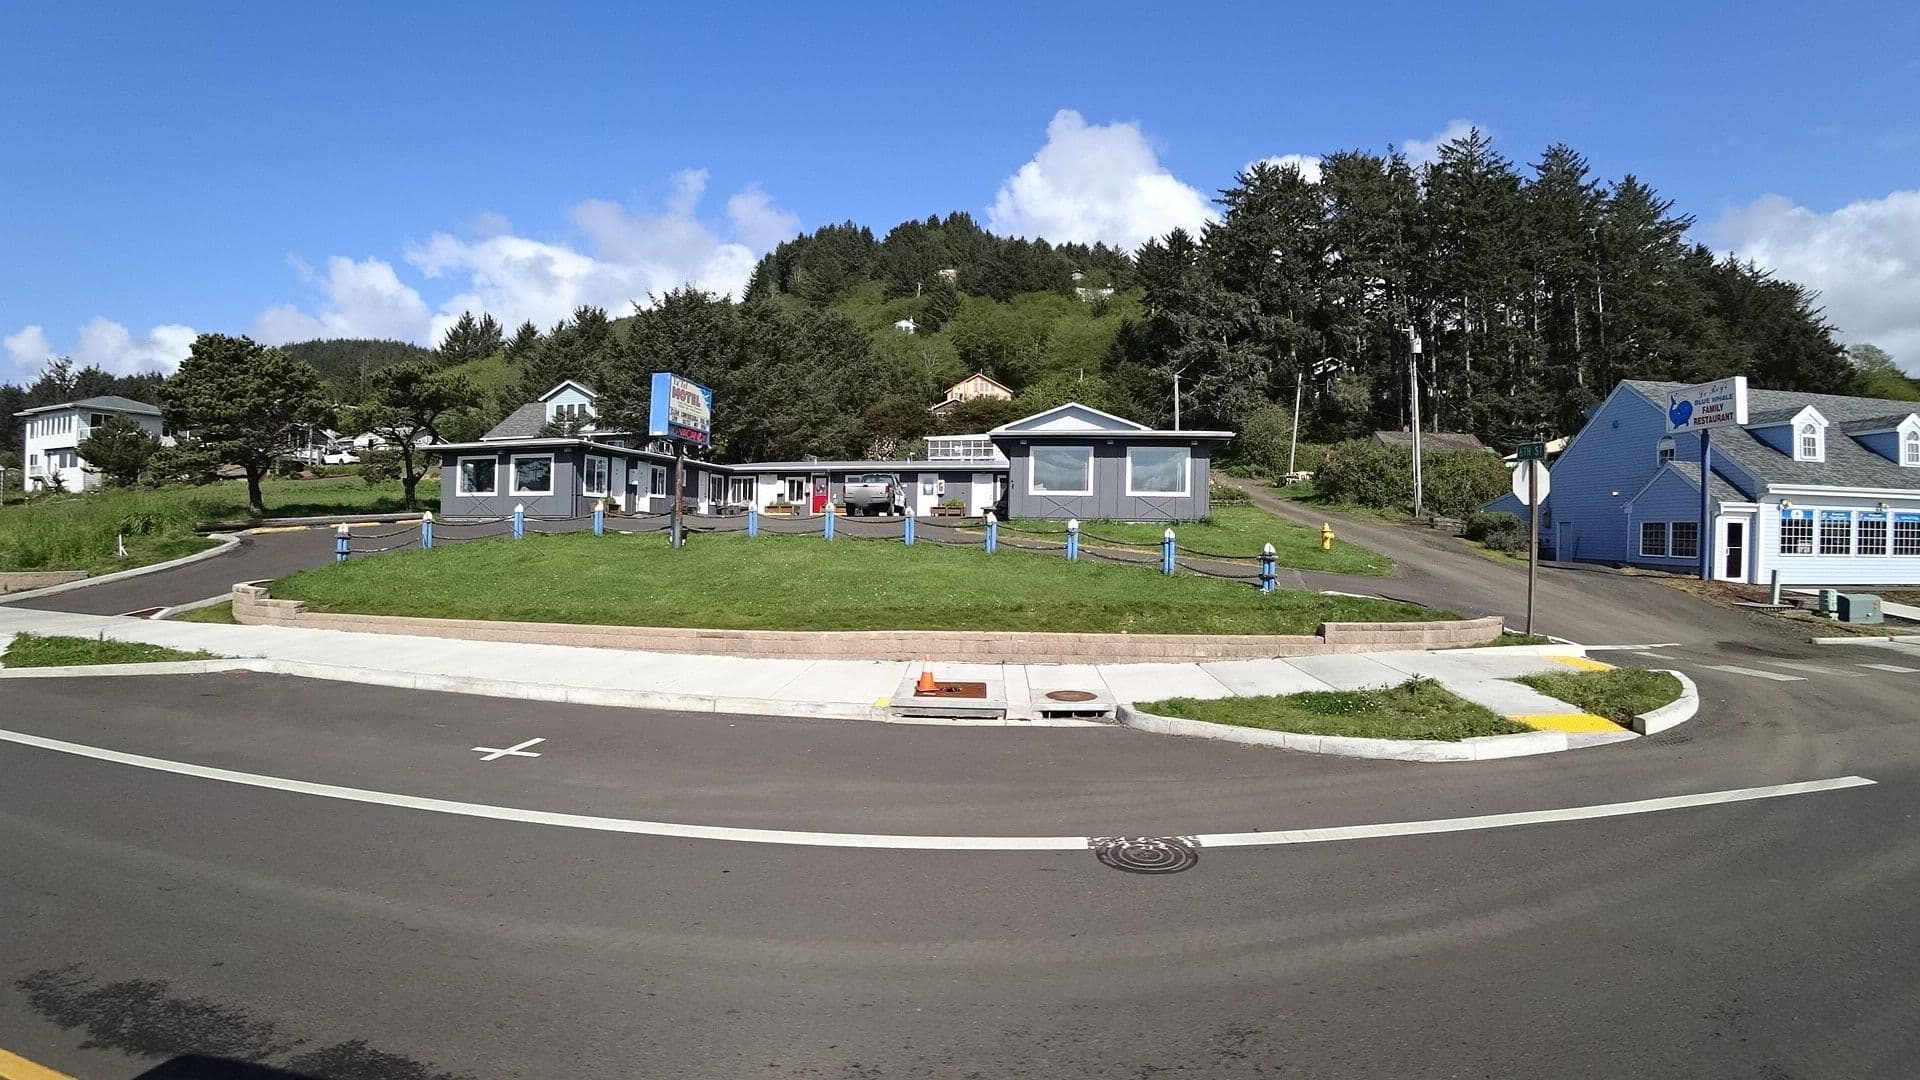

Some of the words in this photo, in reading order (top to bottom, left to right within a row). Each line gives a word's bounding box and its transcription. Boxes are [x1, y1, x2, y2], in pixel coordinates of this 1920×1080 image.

[672, 386, 701, 407] MOTEL
[1694, 397, 1711, 405] BLUE
[1712, 393, 1733, 402] WHALE
[1702, 403, 1724, 414] FAMILY
[1693, 412, 1733, 426] RESTAURANT
